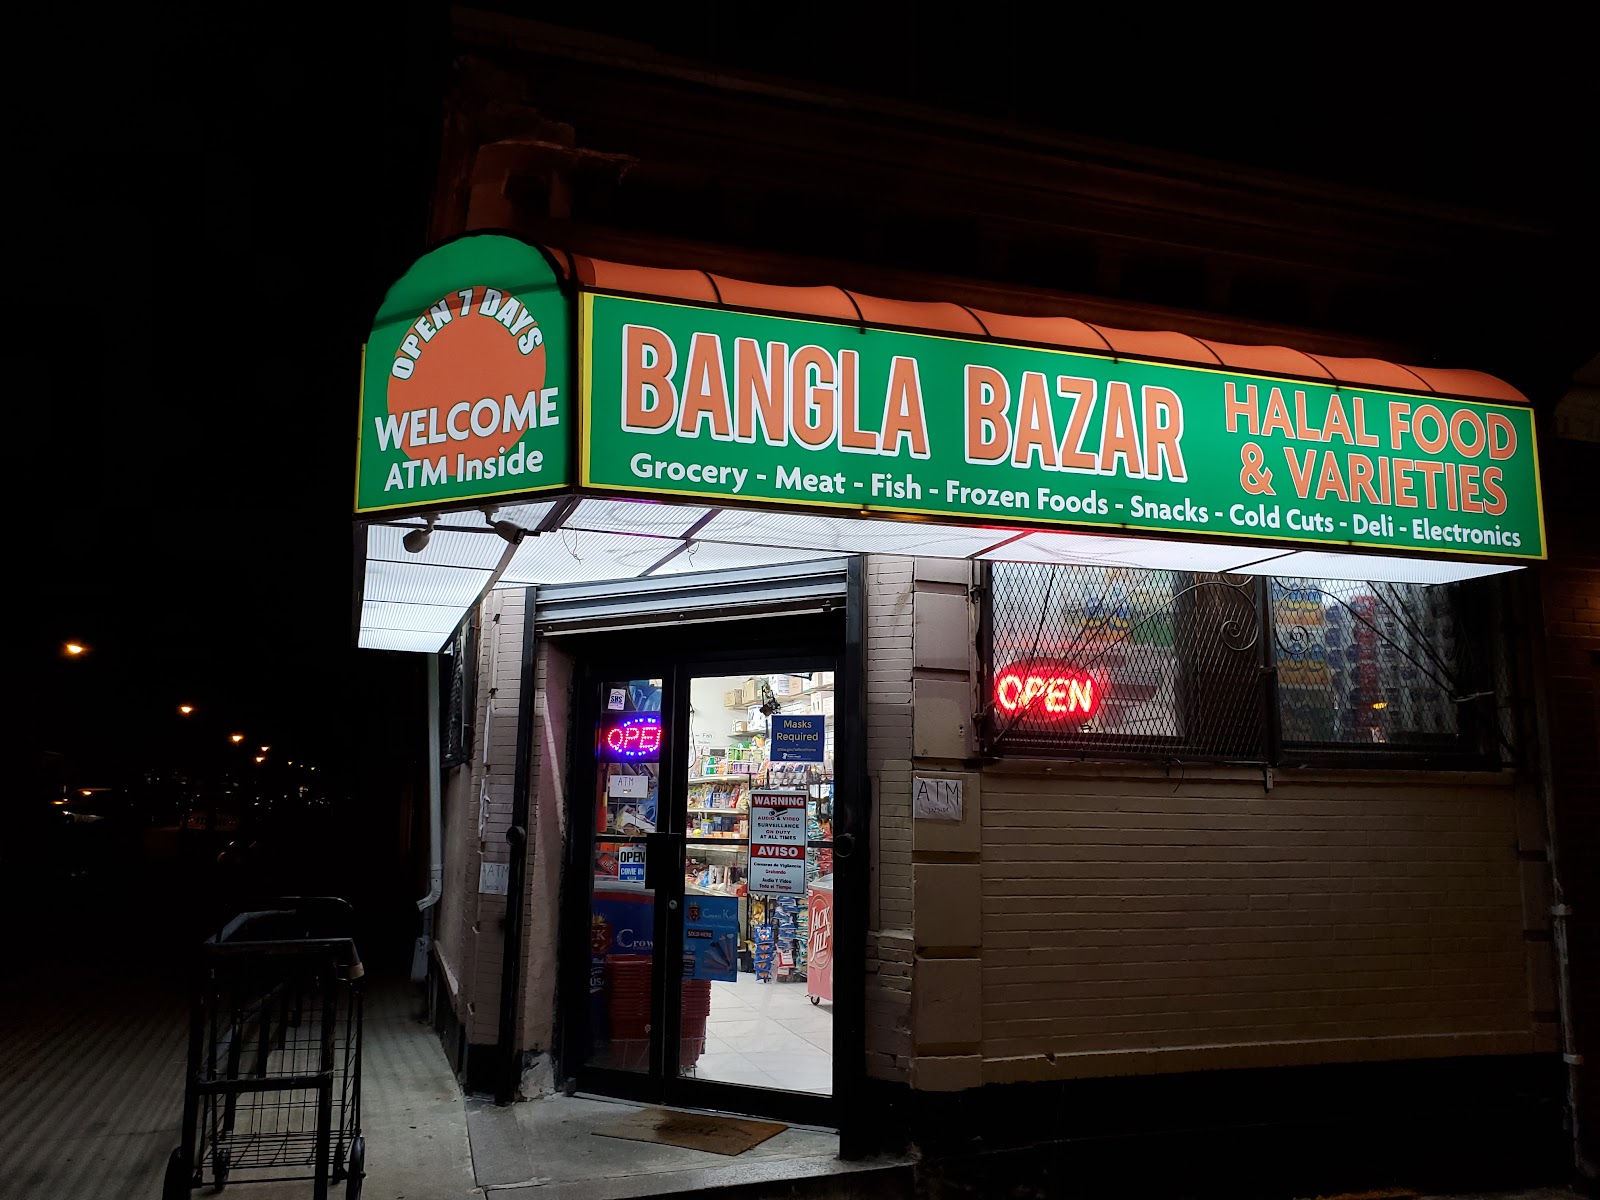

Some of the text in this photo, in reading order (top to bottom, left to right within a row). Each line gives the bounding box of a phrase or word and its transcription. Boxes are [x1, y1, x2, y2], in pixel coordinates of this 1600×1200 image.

[392, 288, 543, 380] OPEN 7 DAYS
[374, 387, 559, 451] WELCOME
[621, 324, 1188, 483] BANGLA BAZAR
[1224, 382, 1517, 460] HALAL FOOD
[384, 442, 544, 492] ATM Inside
[1240, 442, 1508, 516] & VARIETIES
[630, 453, 748, 493] Grocery
[775, 465, 846, 494] Meat
[871, 472, 922, 499] Fish
[946, 480, 1030, 509] Frozen
[1037, 487, 1108, 515] Foods
[1131, 495, 1209, 523] Snacks
[1229, 503, 1280, 529] Cold
[1286, 510, 1334, 533] Cuts
[1353, 514, 1394, 537] Deli
[1412, 518, 1521, 547] Electronics
[997, 674, 1092, 713] OPEN
[776, 732, 819, 742] Required
[783, 719, 812, 728] Masks
[618, 777, 634, 787] ATM
[917, 780, 959, 806] ATM
[754, 796, 805, 806] WARNING
[620, 851, 646, 863] OPEN
[757, 845, 799, 857] AVISO
[620, 867, 644, 876] COME IN
